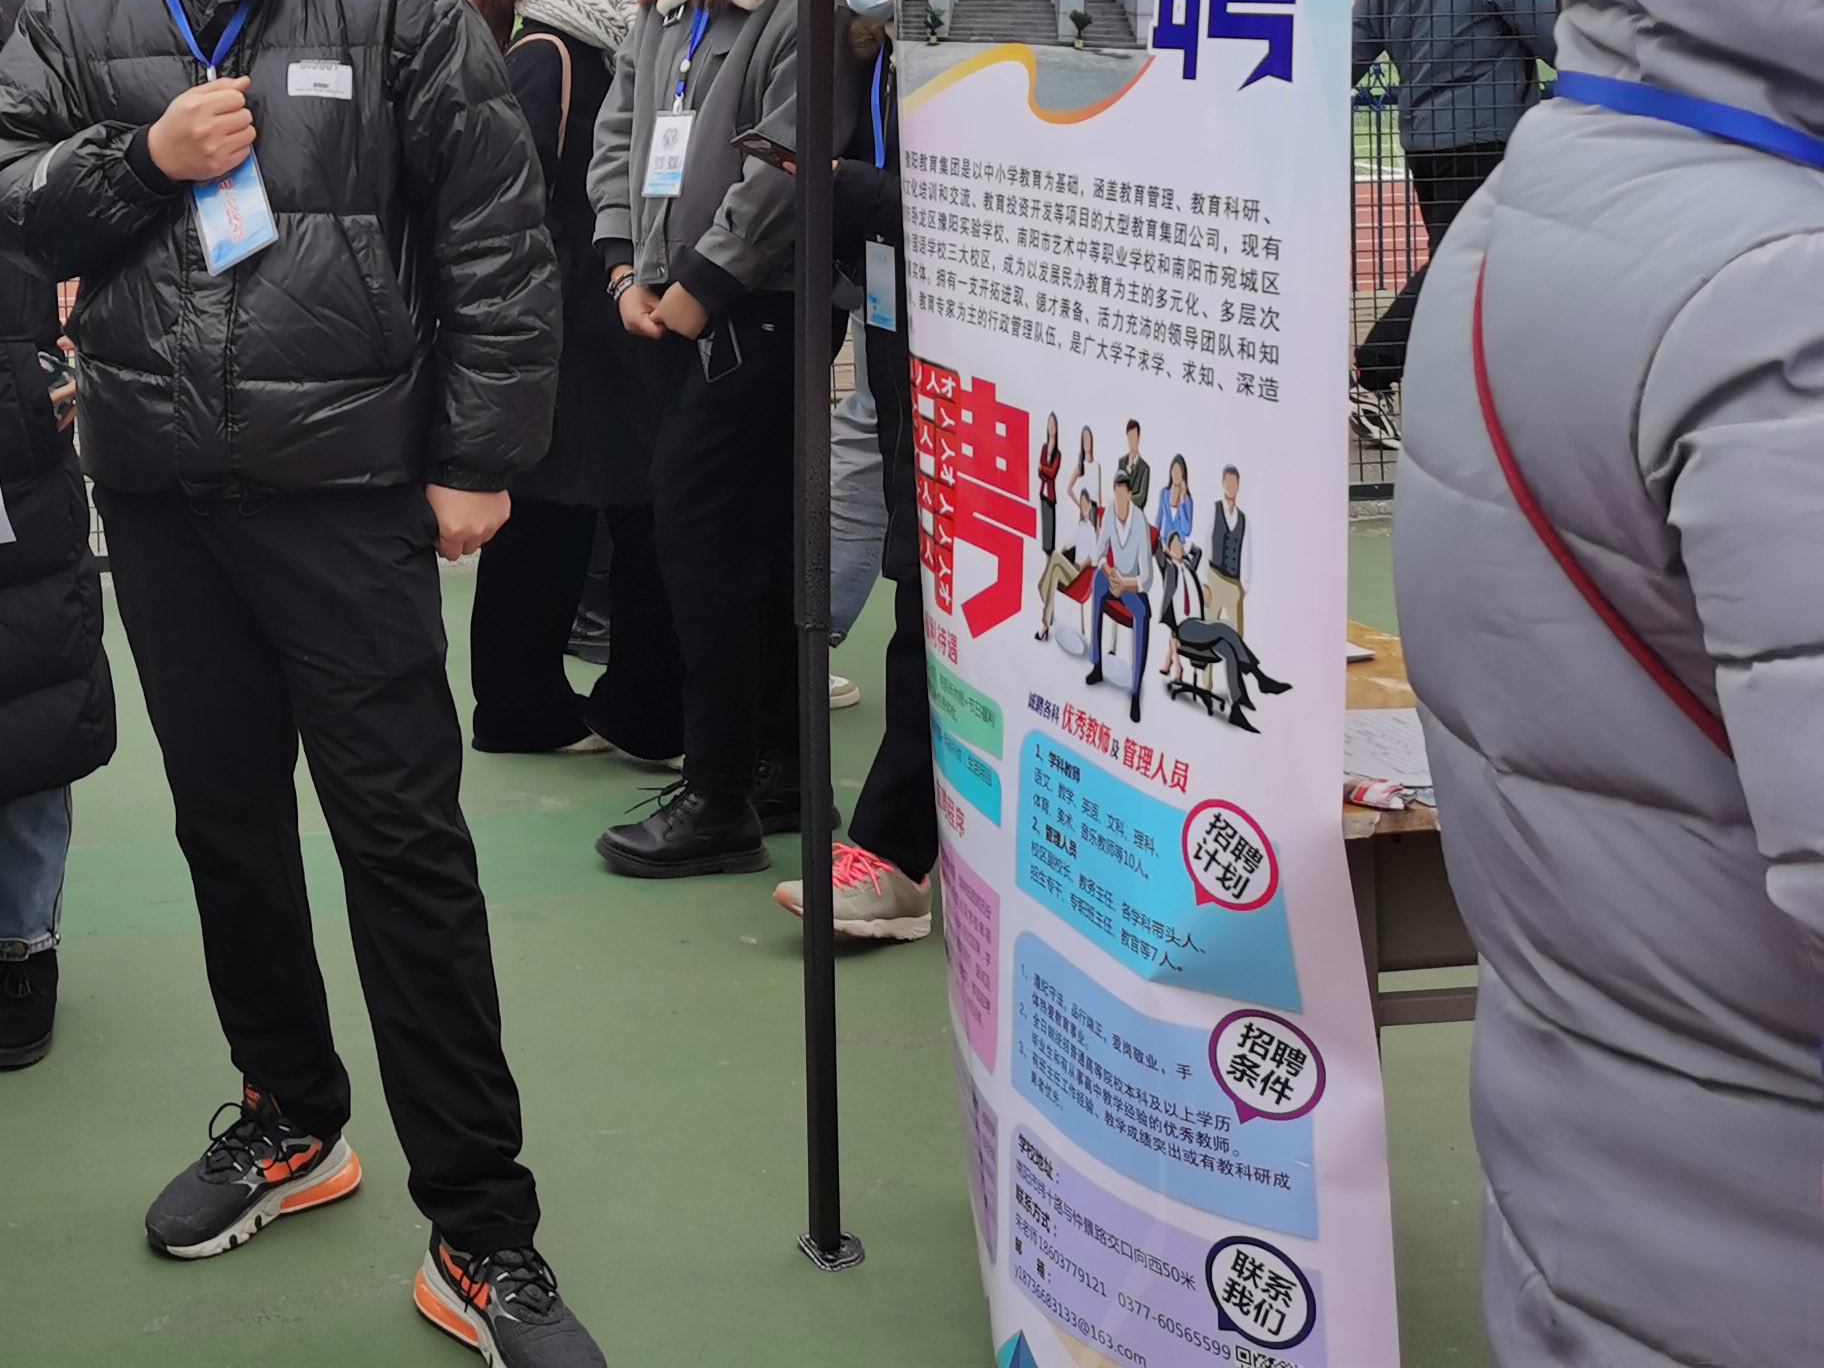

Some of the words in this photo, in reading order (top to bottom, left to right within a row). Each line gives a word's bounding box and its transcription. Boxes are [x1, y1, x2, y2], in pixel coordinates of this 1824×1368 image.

[903, 179, 1282, 261] 文化培训和交流、教育投资开发等项目的大型教育集团公司，现有
[906, 234, 1280, 332] 国语学校三大校区，成为以发展民办教育为主的多元化、多层次
[907, 259, 1279, 365] 实体。拥有一支开拓进取、德才兼备、活力充沛的领导团队和知
[909, 287, 1279, 402] 、教育专家为主的行政管理队伍，是广大学子求学、求知、深造
[1062, 701, 1112, 755] 优秀教师
[1110, 738, 1120, 760] 及
[1122, 736, 1190, 794] 管理人员
[1193, 837, 1251, 900] 计划
[1204, 811, 1264, 875] 招聘
[1226, 1053, 1295, 1107] 条件
[1236, 1021, 1308, 1079] 招聘
[1221, 1277, 1287, 1336] 我们
[1230, 1248, 1298, 1308] 联系
[1117, 1291, 1232, 1361] 0377-60565599
